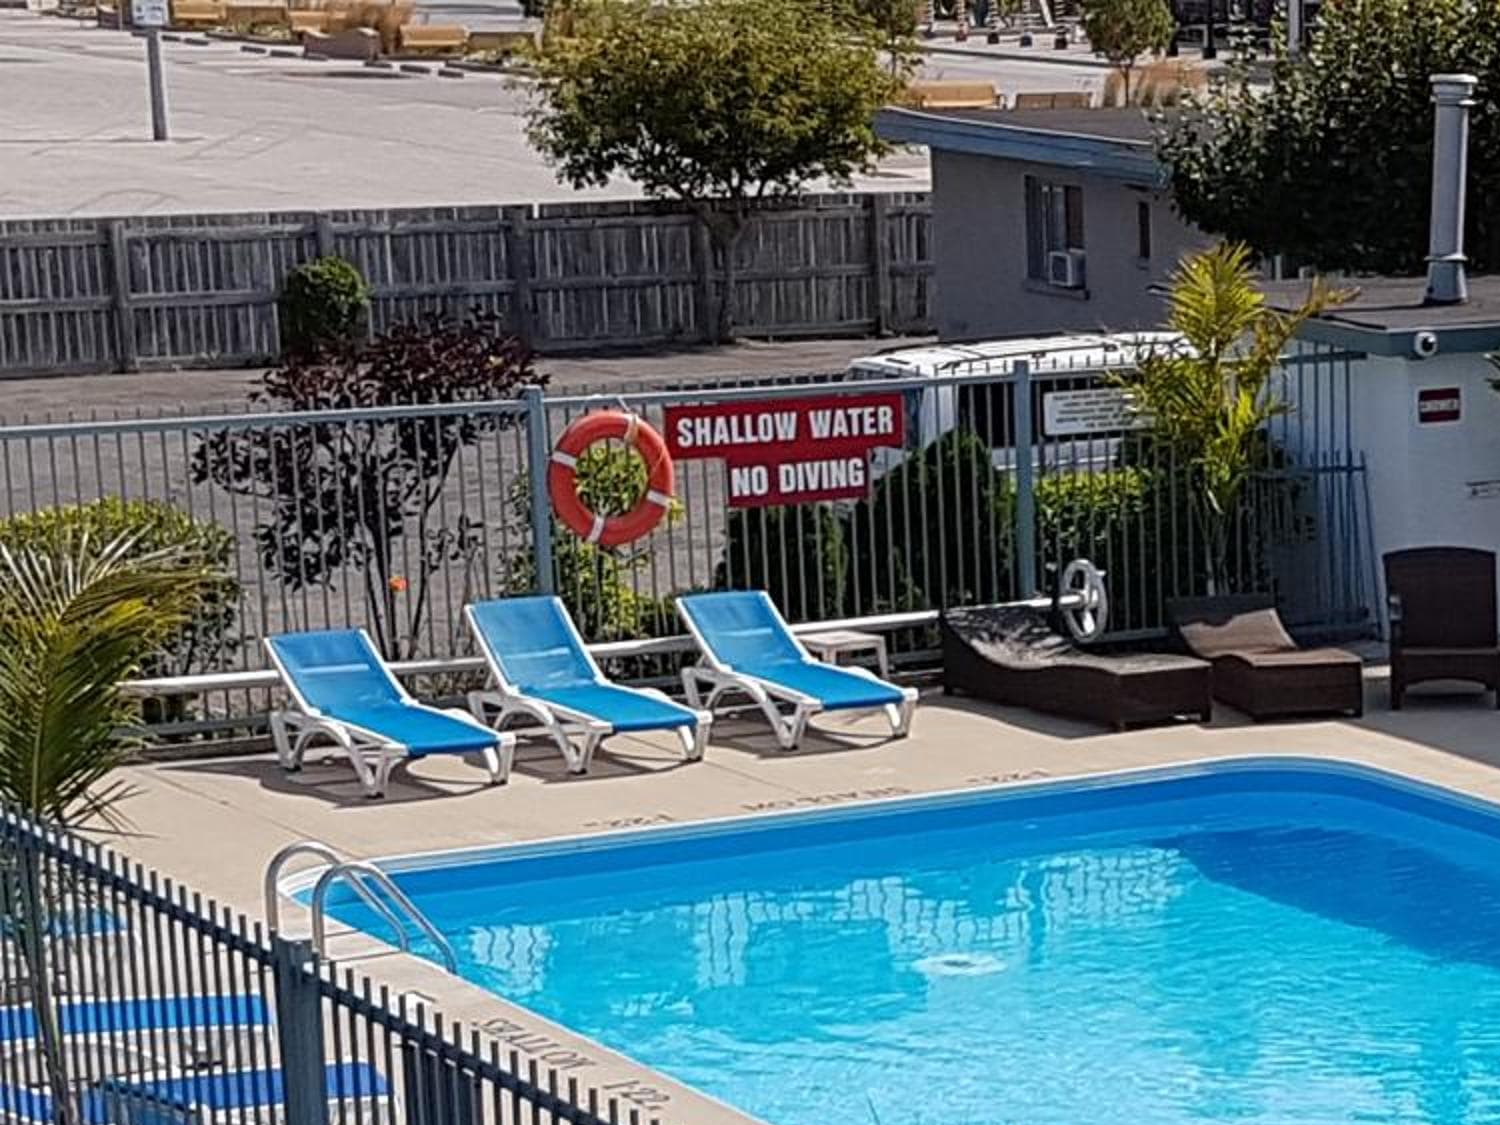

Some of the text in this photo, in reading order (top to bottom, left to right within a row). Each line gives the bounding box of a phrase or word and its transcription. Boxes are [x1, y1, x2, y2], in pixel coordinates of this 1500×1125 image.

[677, 406, 893, 448] SHALLOW WATER
[731, 457, 864, 497] NO DIVING
